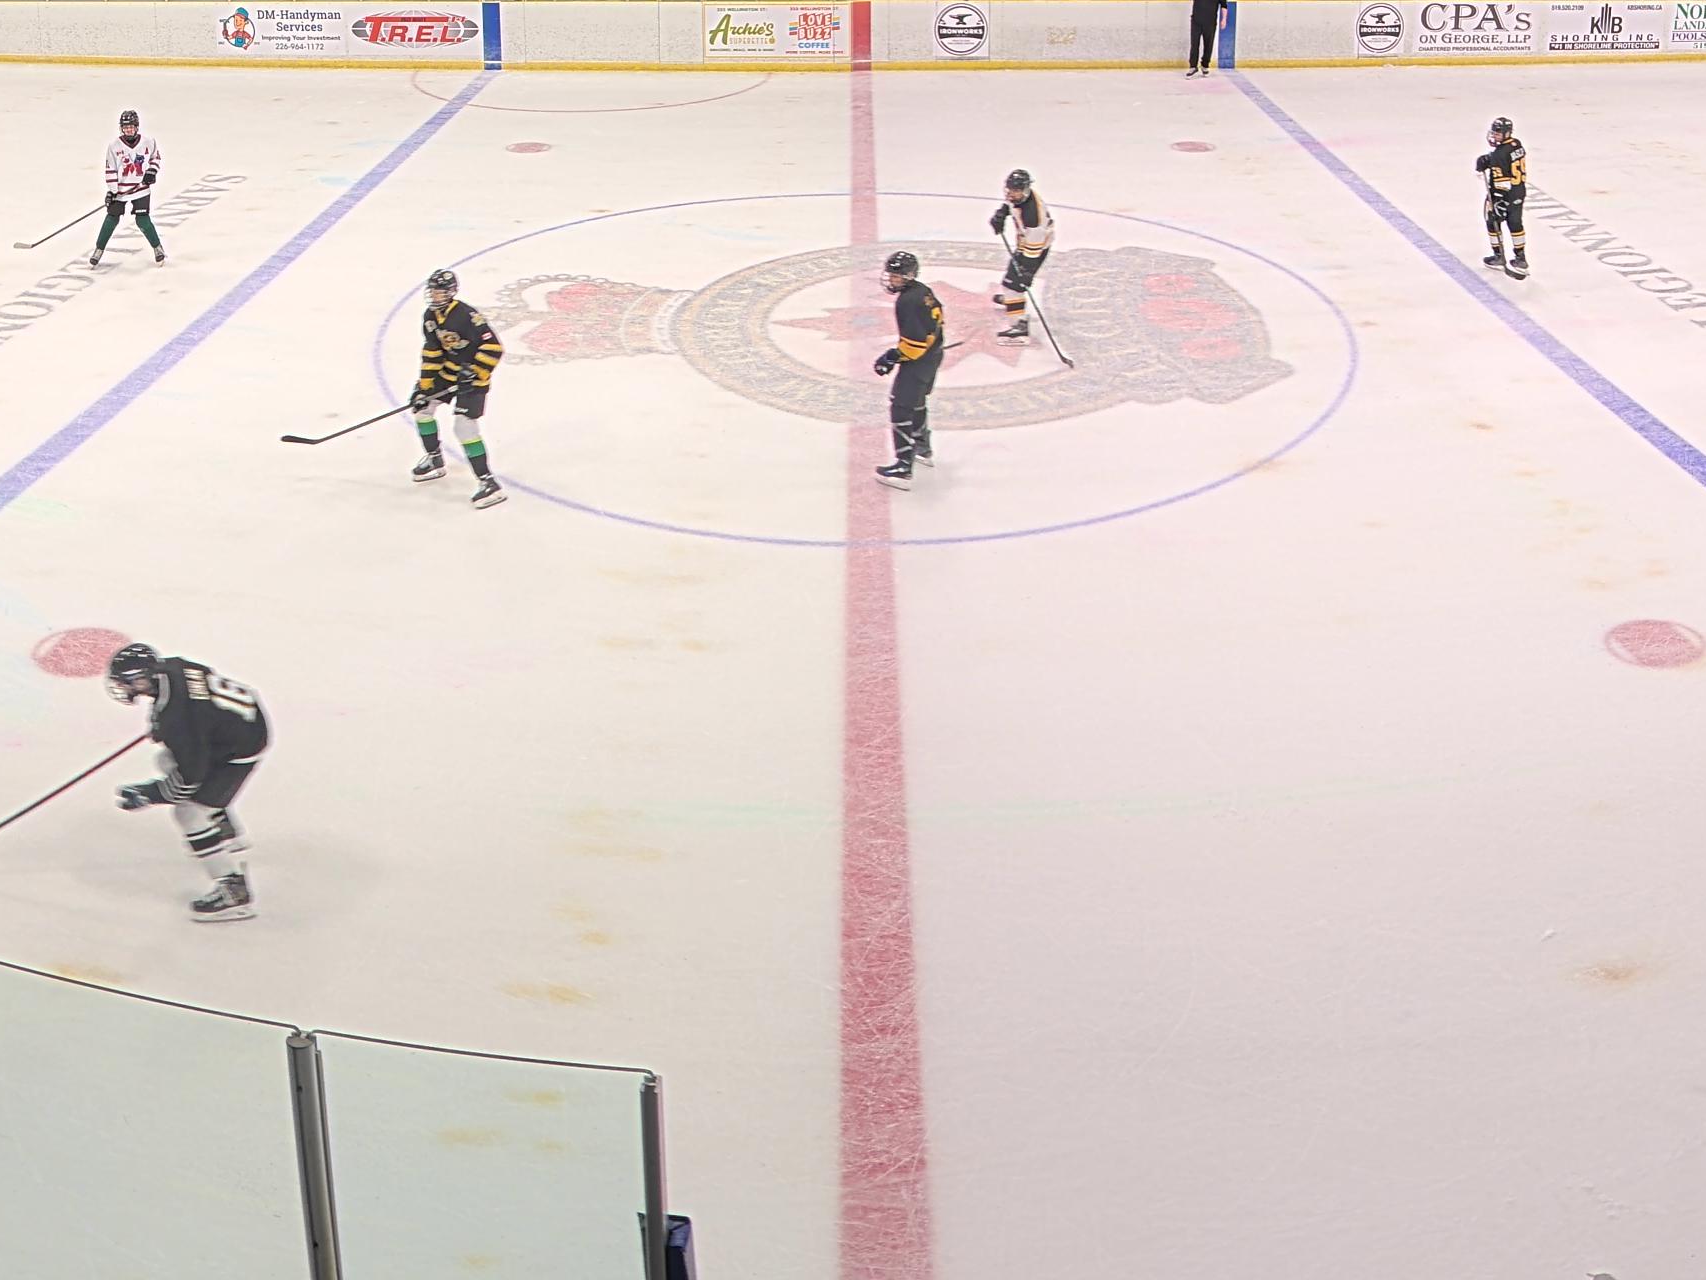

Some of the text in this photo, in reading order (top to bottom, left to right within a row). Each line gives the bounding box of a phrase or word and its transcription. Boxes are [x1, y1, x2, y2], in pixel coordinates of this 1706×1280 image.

[257, 9, 341, 22] DM-Handyman
[799, 13, 833, 27] LOVE
[276, 22, 323, 32] Services
[364, 16, 463, 43] T.R.E.L.
[798, 26, 832, 41] BUZZ
[1419, 33, 1531, 45] ON GEORGE, LLP
[1551, 34, 1619, 42] SHORING
[1672, 32, 1706, 41] POOLS
[275, 43, 324, 51] 226-964-1172
